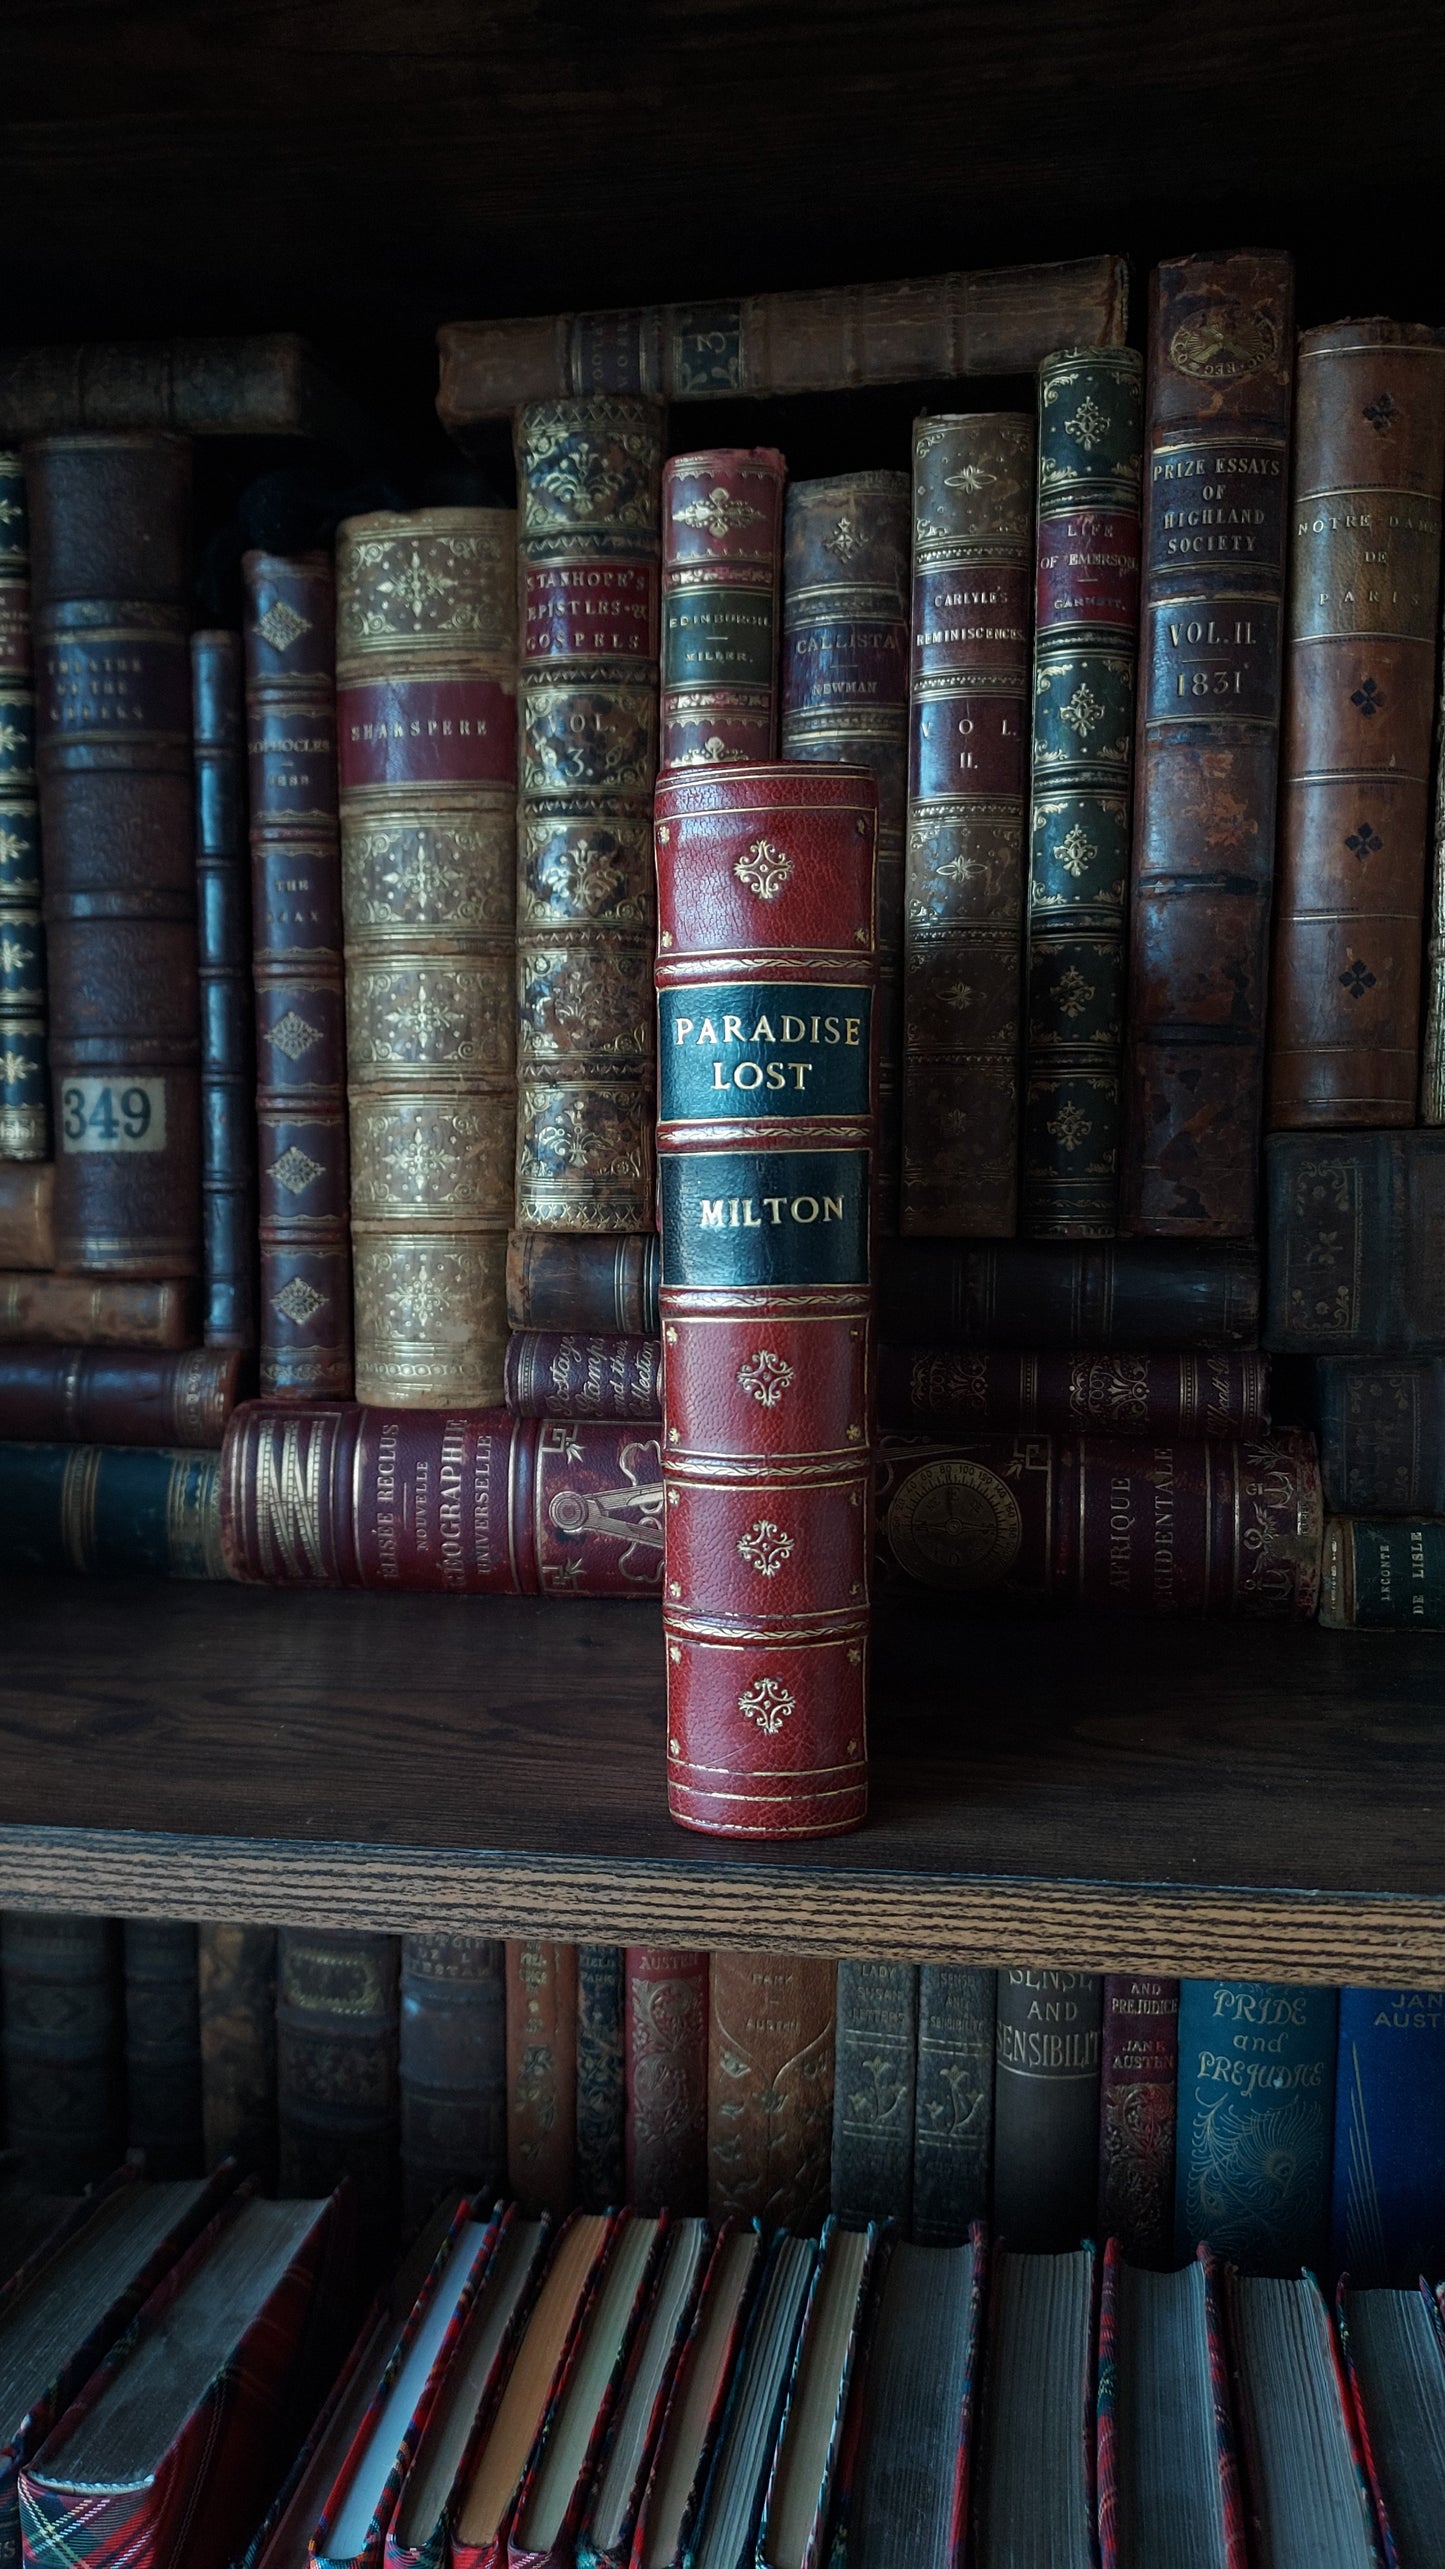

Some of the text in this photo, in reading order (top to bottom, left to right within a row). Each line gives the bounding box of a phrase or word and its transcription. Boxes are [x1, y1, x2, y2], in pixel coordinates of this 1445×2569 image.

[1153, 457, 1281, 482] PRIZE ESSAYS
[1202, 485, 1228, 501] OF
[1163, 509, 1266, 530] HIGHLAND
[1067, 523, 1114, 539] LIFE
[1167, 535, 1258, 555] SOCIETY
[1040, 554, 1060, 571] OF
[1364, 550, 1389, 565] DE
[934, 586, 1010, 608] CARLYLE'S
[526, 632, 642, 651] GOSPELS
[796, 634, 899, 655] CALLISTA
[812, 679, 880, 696] NEWMAN
[1177, 670, 1242, 698] 1831
[349, 720, 489, 742] SHAKSPERE
[675, 1014, 862, 1047] PARADISE
[711, 1061, 814, 1091] LOST
[64, 1086, 151, 1140] 349
[699, 1195, 846, 1228] MILTON
[376, 1424, 400, 1504] RECLUS
[415, 1461, 430, 1552] NOUVELLE
[474, 1435, 493, 1576] UNIVERSELLE
[1110, 1477, 1136, 1593] AFRIQUE
[1410, 1531, 1425, 1616] DE LISLE
[639, 1952, 699, 1971] AUSTEN
[861, 1963, 898, 1980] LADY
[857, 1985, 905, 2002] SUSAN
[1131, 1982, 1163, 1997] AND
[1027, 2000, 1079, 2021] AND
[1111, 1997, 1178, 2016] PREJUDICE
[1213, 1989, 1308, 2026] PRIDE
[1122, 2040, 1167, 2053] JANE
[1232, 2031, 1289, 2054] and
[1111, 2054, 1175, 2070] AUSTEN
[1196, 2050, 1328, 2099] PREJUDICE
